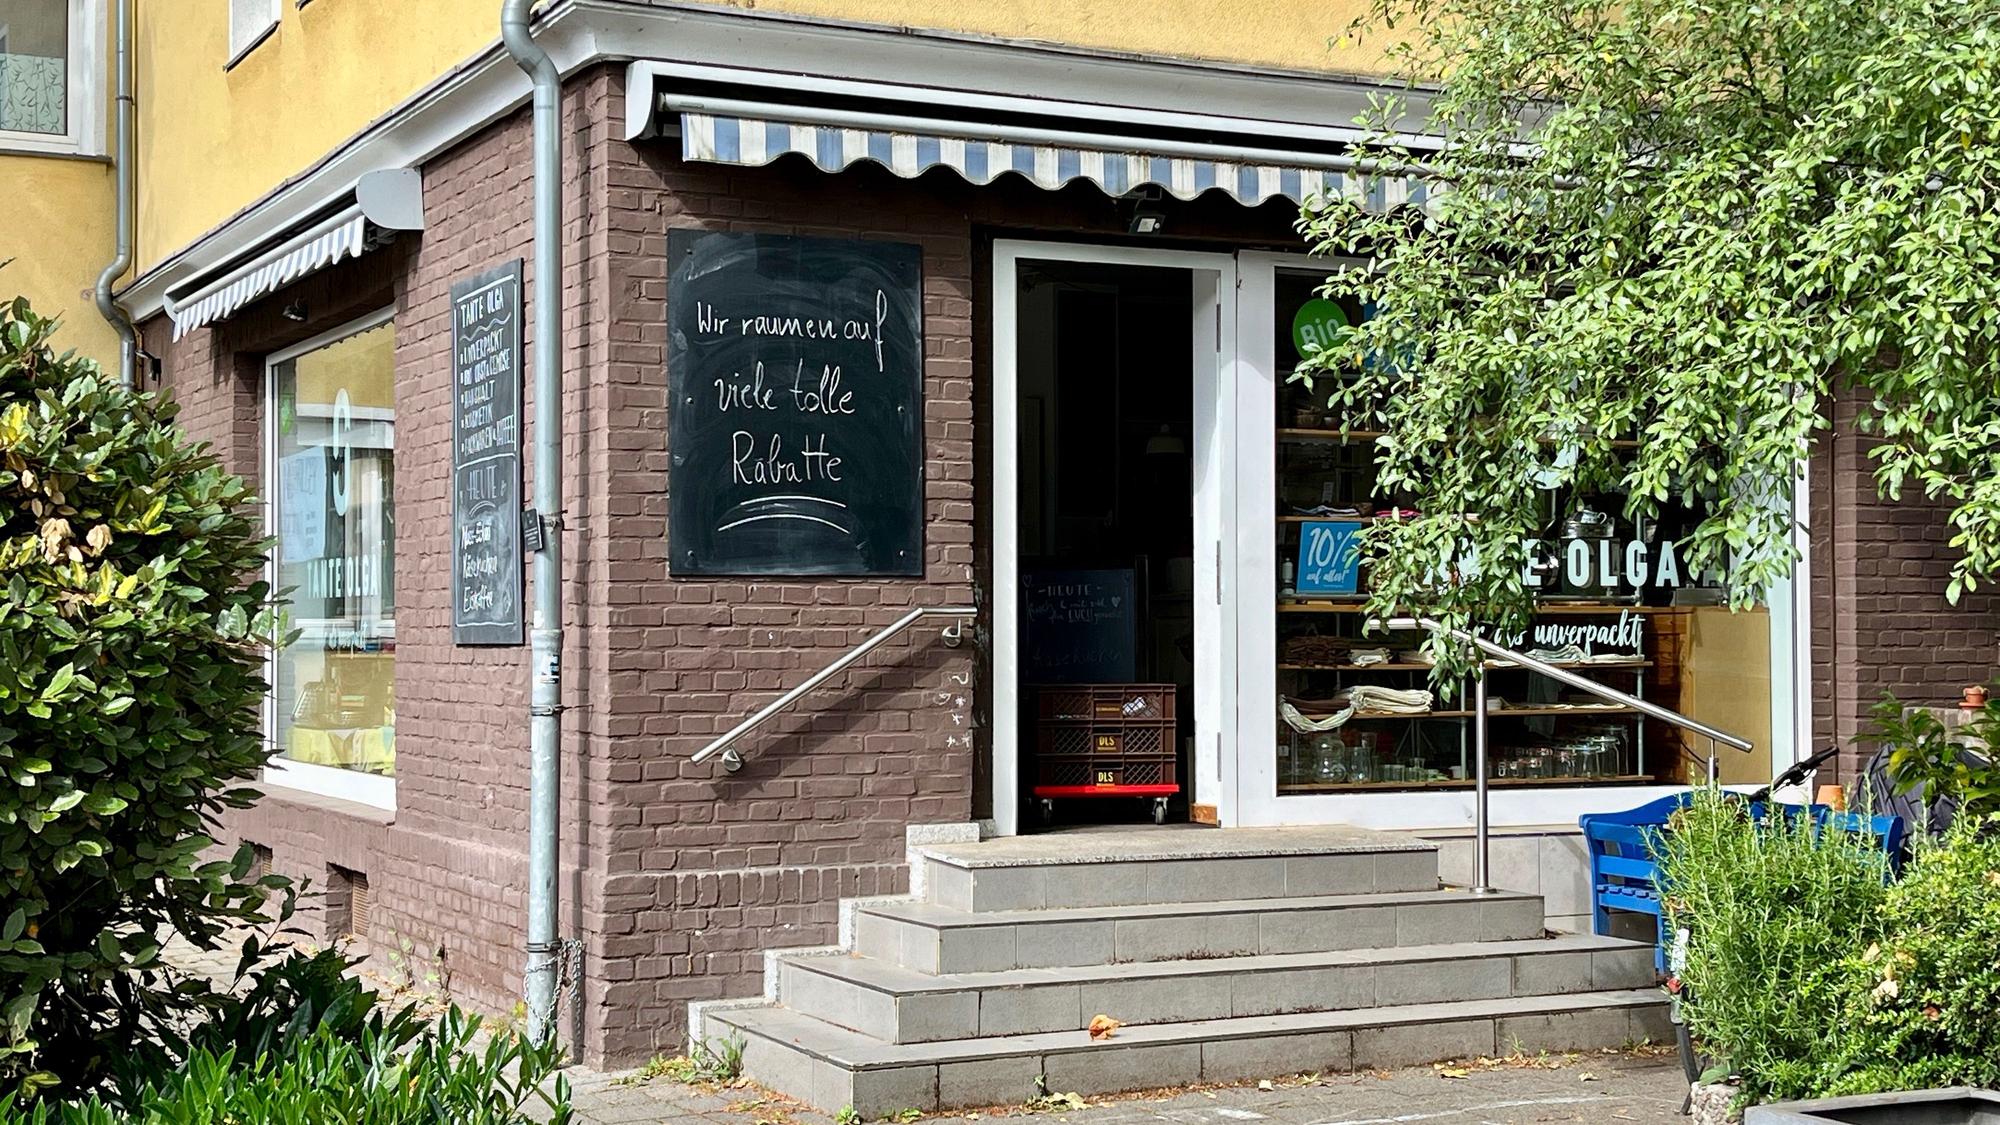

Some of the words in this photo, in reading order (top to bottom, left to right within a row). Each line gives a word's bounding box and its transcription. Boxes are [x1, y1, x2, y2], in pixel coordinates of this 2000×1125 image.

[461, 295, 483, 328] TANTE
[487, 285, 504, 314] OLGA
[697, 301, 729, 335] Wir
[843, 289, 887, 372] auf
[714, 361, 778, 412] viele
[789, 357, 856, 414] tolle
[469, 464, 498, 501] HEUTE
[306, 557, 342, 600] TANTE
[347, 553, 379, 598] OLGA
[1567, 538, 1680, 588] OLGA
[1534, 608, 1646, 657] unverpackt
[1099, 735, 1115, 747] DLS
[1098, 771, 1114, 783] DLS
